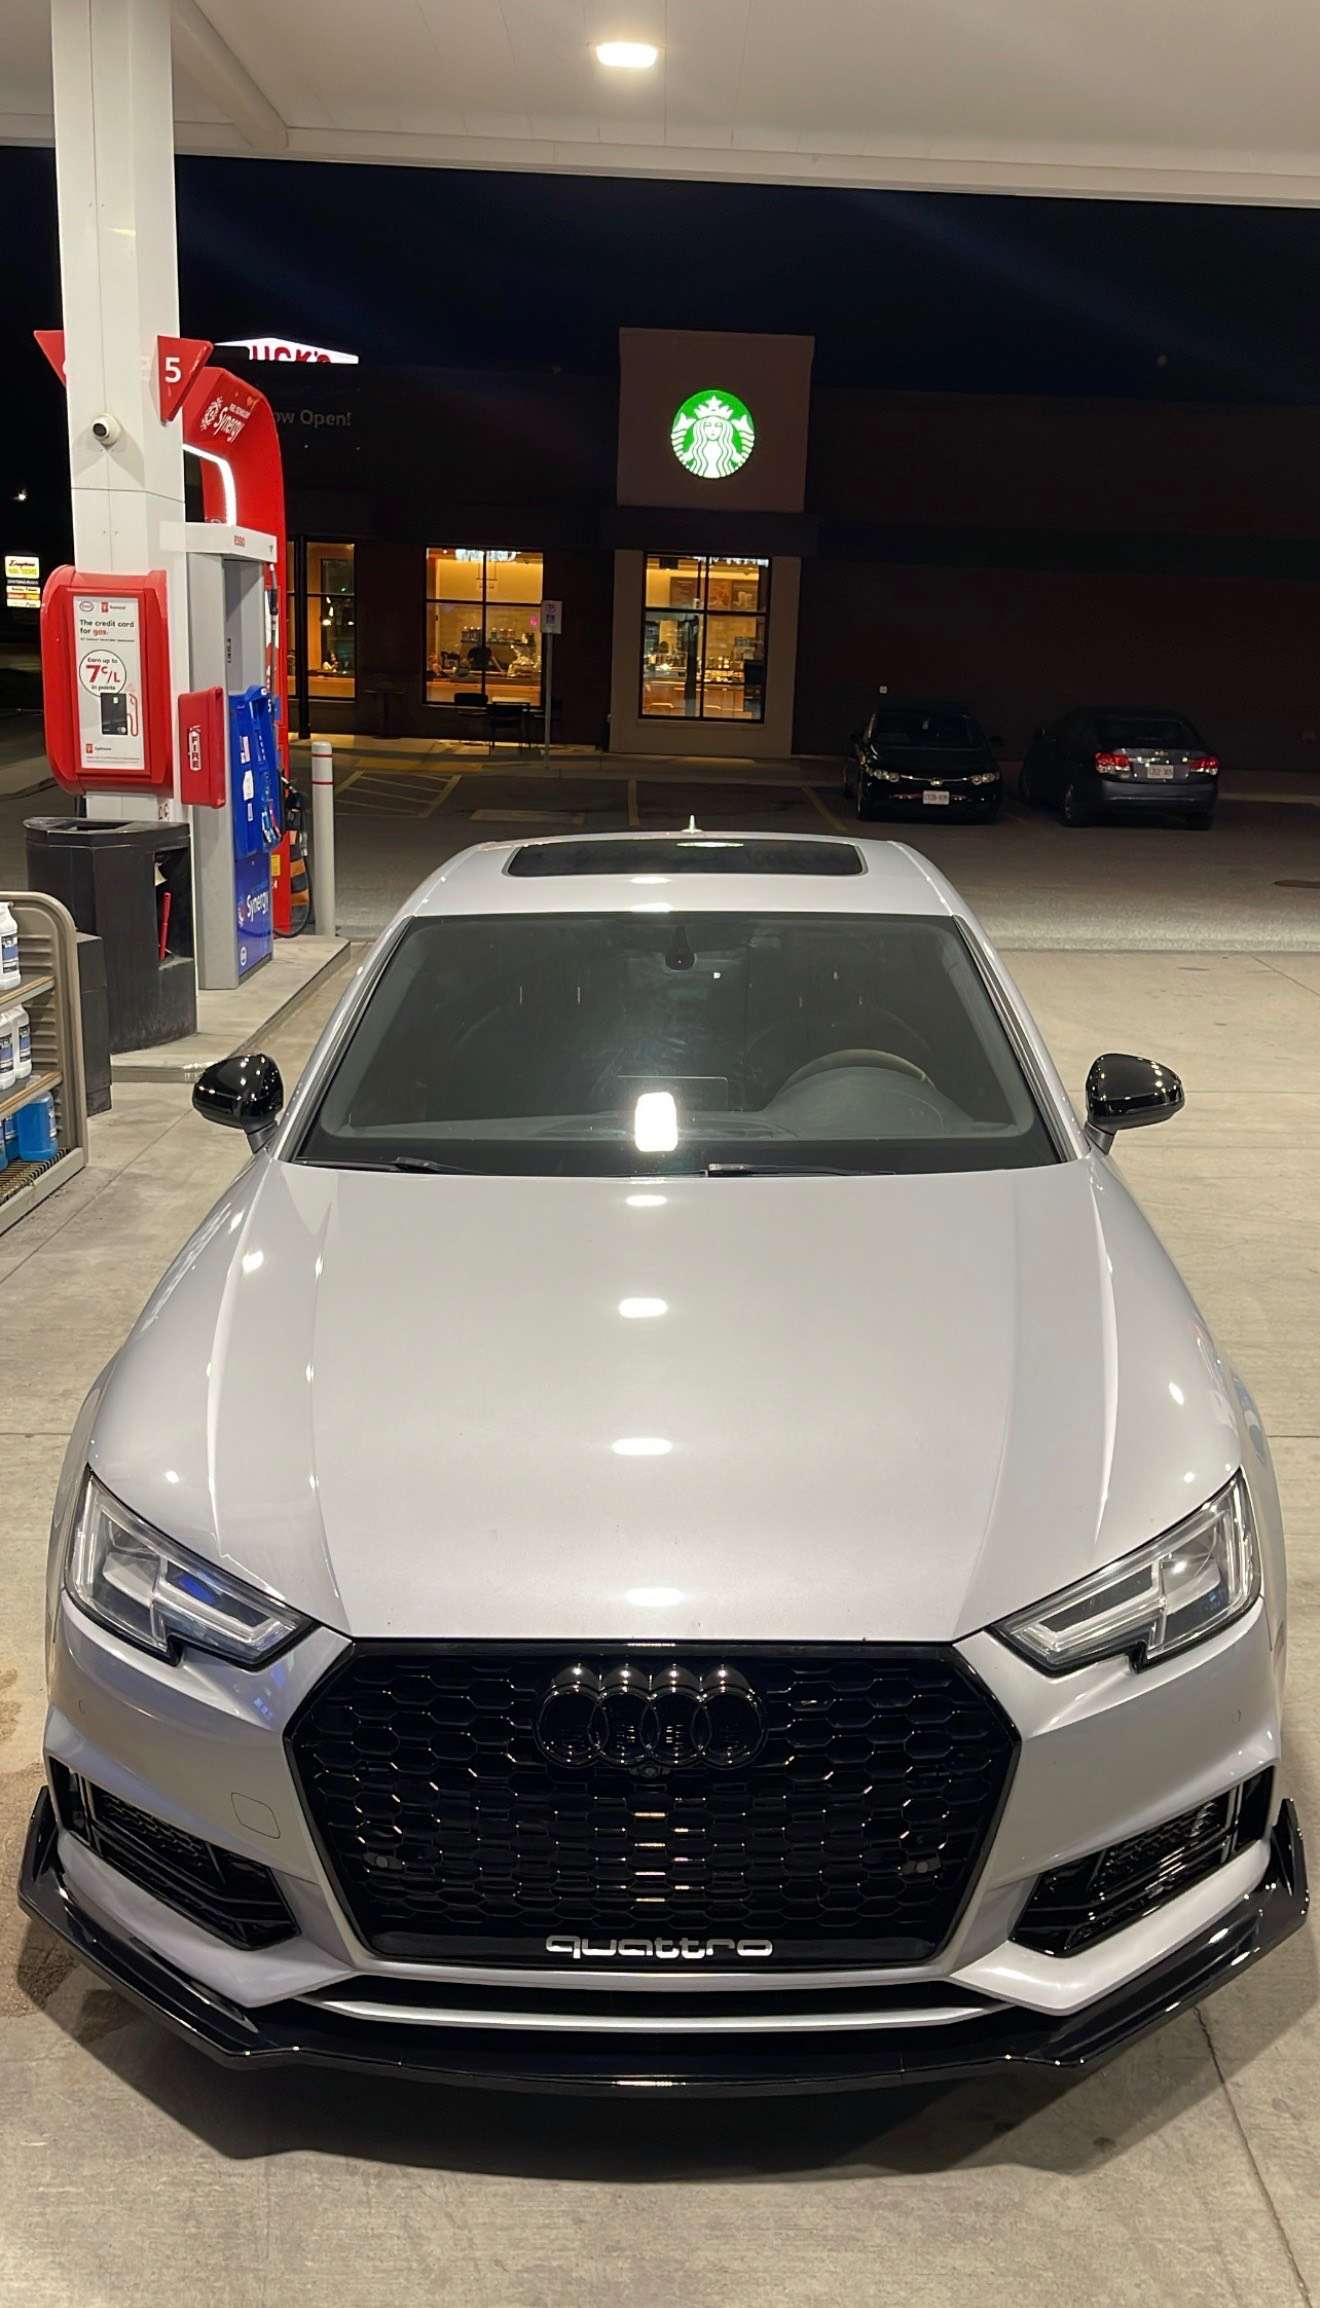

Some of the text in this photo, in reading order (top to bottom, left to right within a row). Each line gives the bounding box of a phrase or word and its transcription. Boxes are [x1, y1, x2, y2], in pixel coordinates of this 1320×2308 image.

[164, 356, 182, 383] 5
[213, 405, 246, 443] Synergy
[300, 409, 352, 429] Open!
[80, 619, 93, 627] The
[117, 620, 135, 628] card
[191, 735, 200, 769] FIRE
[246, 890, 270, 923] Synergy
[545, 1935, 773, 1960] quattro
